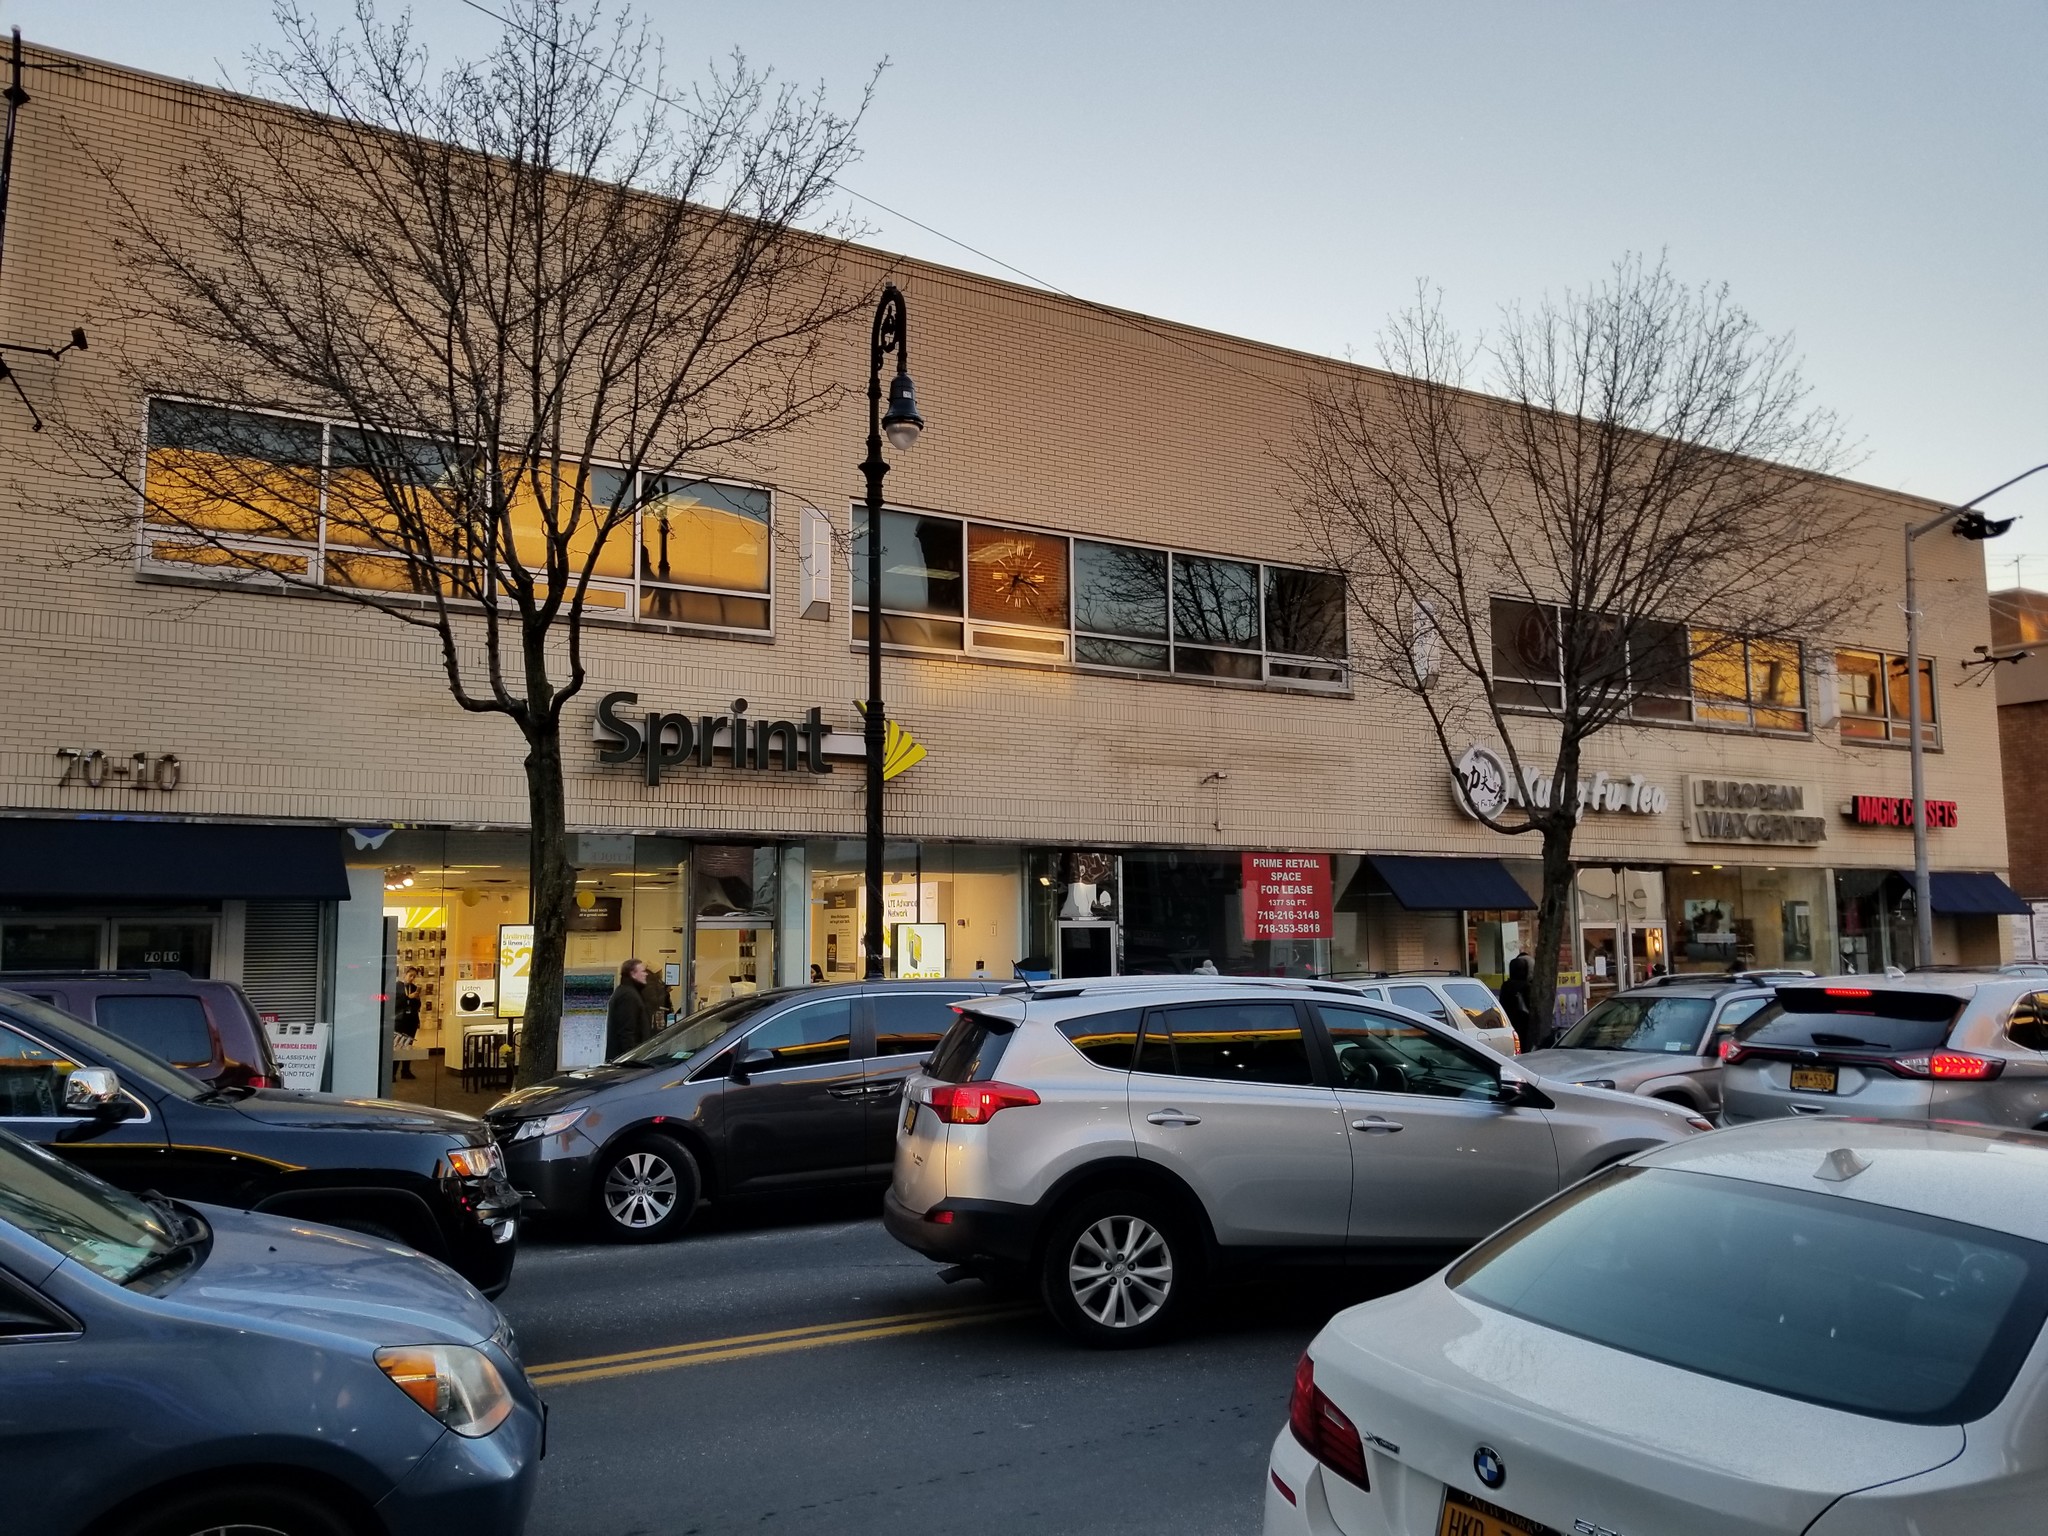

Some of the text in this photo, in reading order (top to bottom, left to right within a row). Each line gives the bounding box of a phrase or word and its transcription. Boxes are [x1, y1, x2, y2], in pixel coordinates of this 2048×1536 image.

[596, 691, 833, 787] Sprint
[56, 748, 180, 791] 70-10
[1591, 771, 1623, 811] Fu
[1628, 774, 1668, 814] Tea
[1694, 779, 1805, 811] EUROPEAN
[1858, 796, 1899, 825] MAGIC
[1696, 811, 1827, 842] WAX CENTER
[1253, 858, 1319, 868] PRIME RETAIL
[1270, 872, 1302, 881] SPACE
[1260, 885, 1313, 894] FOR LEASE
[1257, 910, 1320, 919] 718-216-3148
[1258, 923, 1320, 933] 718-353-5818
